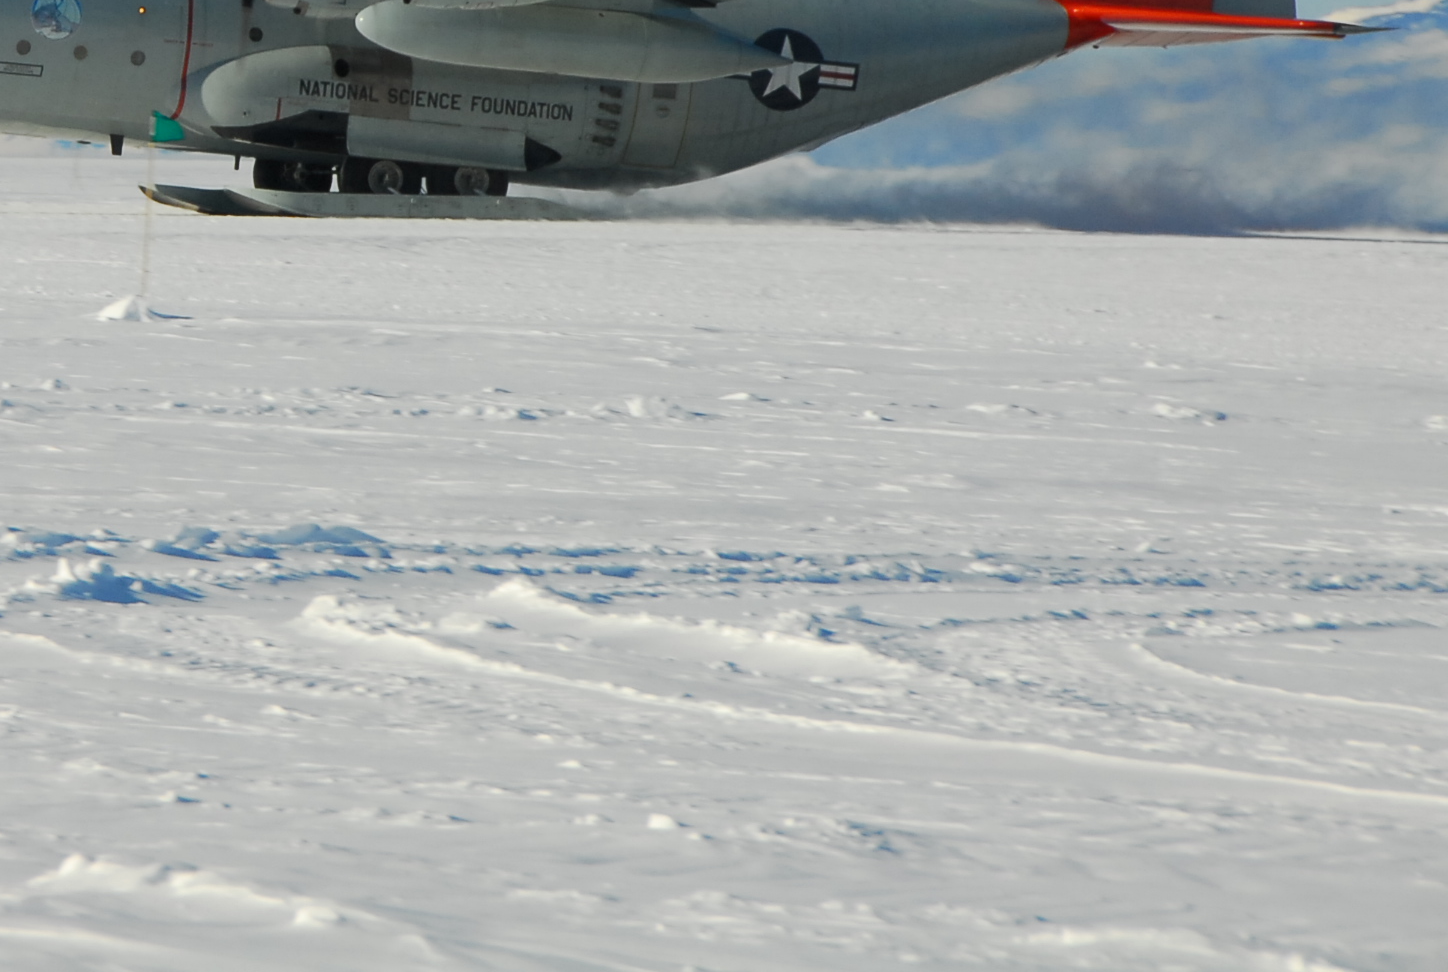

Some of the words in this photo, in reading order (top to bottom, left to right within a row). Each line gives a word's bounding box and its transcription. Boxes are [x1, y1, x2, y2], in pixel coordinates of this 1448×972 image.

[298, 78, 380, 103] NATIONAL
[387, 88, 462, 111] SCIENCE
[470, 95, 574, 122] FOUNDATION
